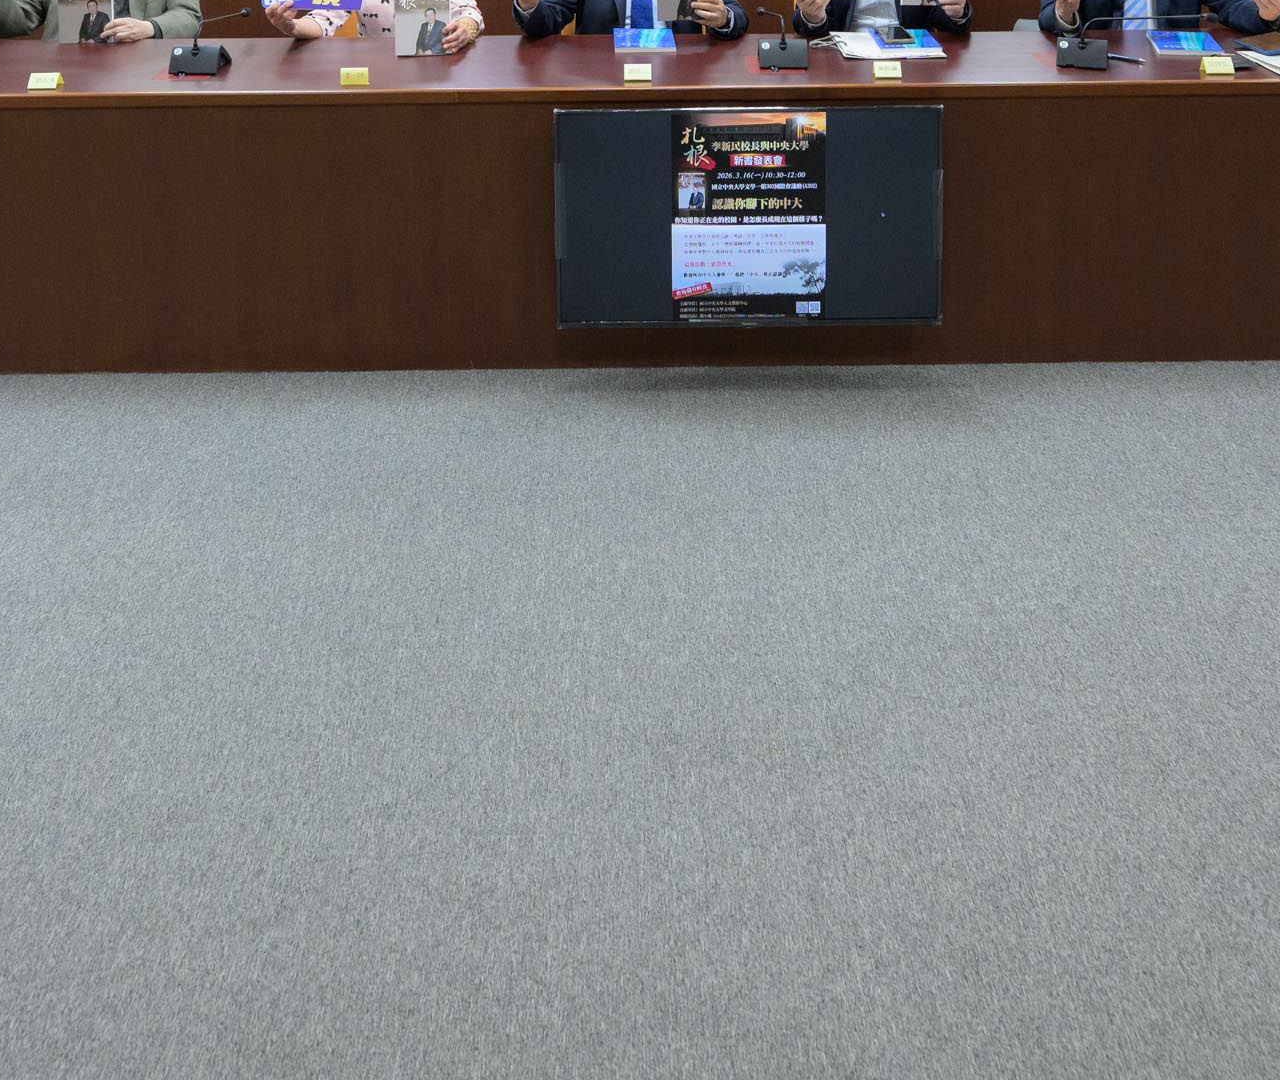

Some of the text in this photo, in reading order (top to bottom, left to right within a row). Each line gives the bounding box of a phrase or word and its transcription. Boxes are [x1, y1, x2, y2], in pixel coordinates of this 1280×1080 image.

[711, 140, 809, 152] 李新民校長與中央大學
[733, 155, 783, 166] 新書發表會
